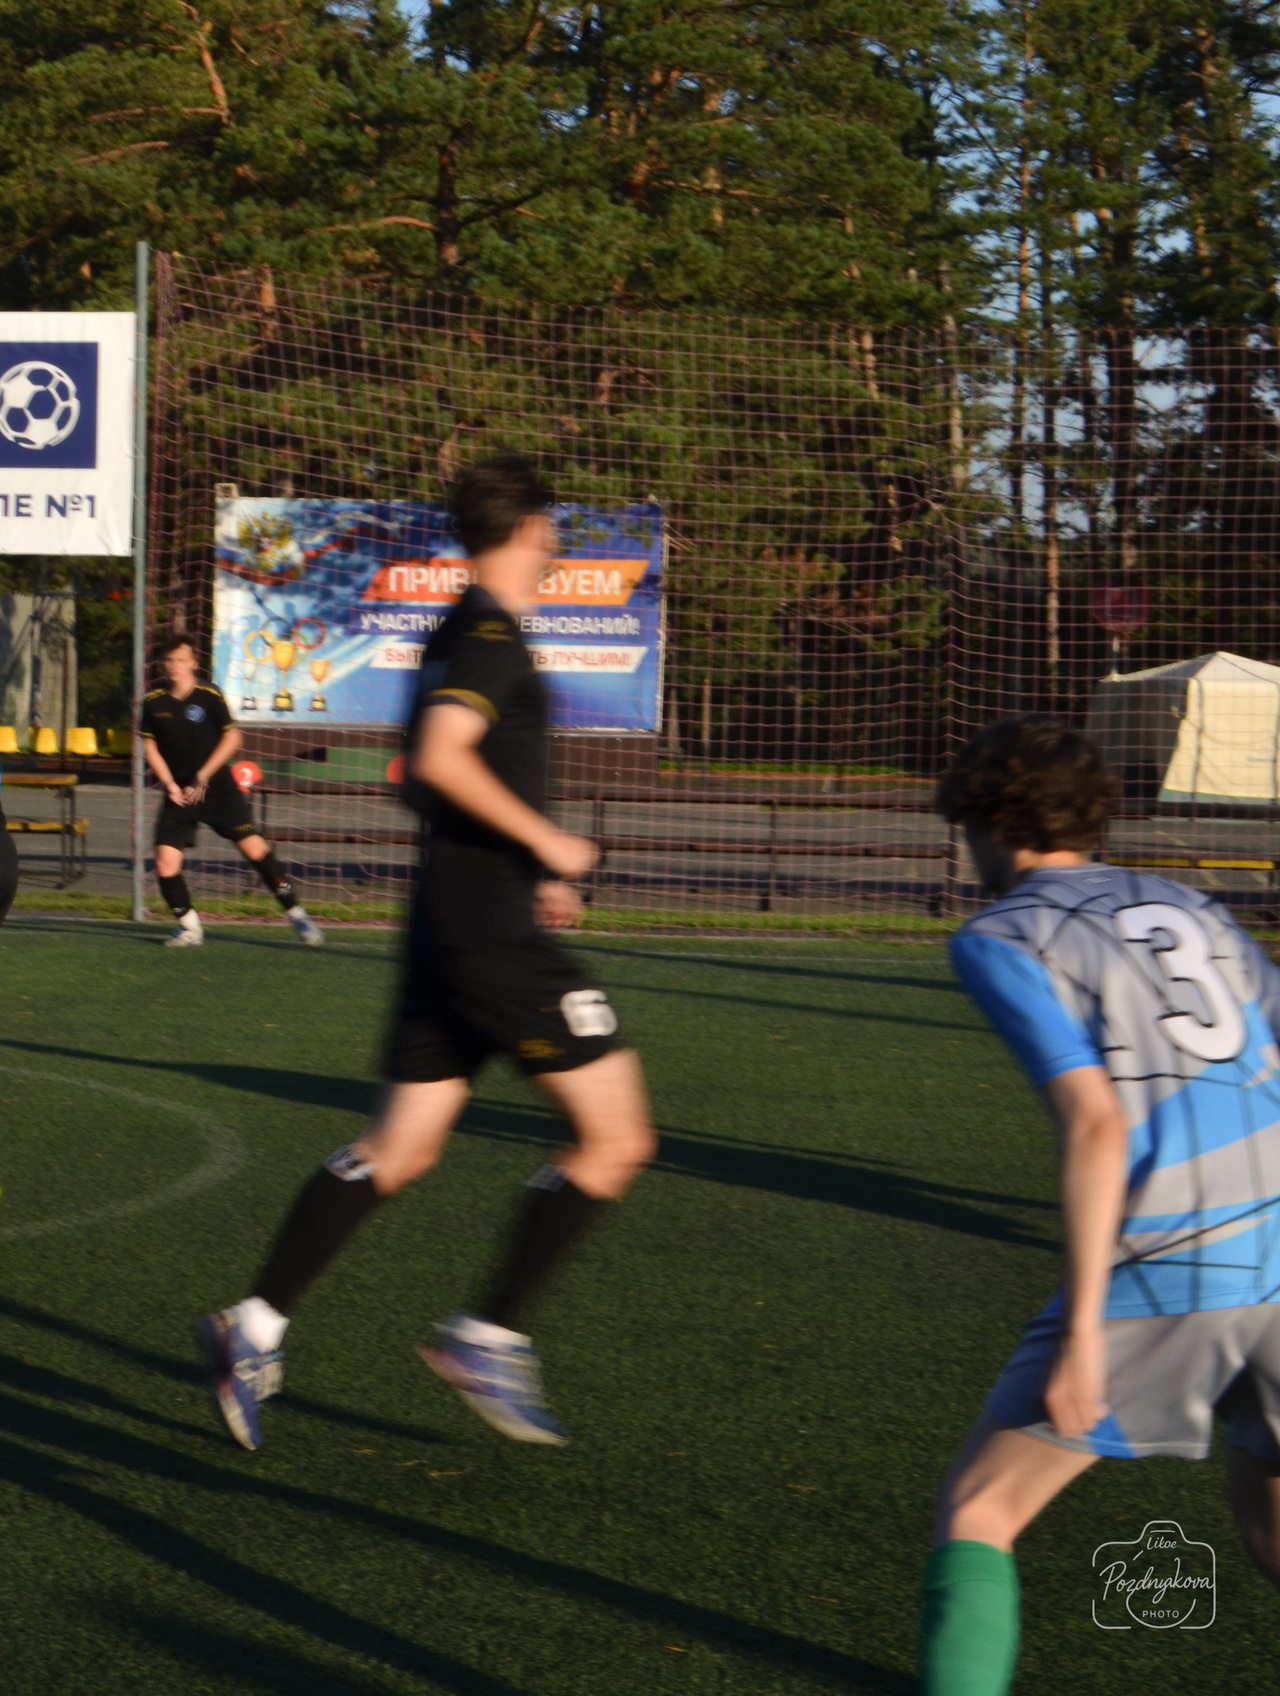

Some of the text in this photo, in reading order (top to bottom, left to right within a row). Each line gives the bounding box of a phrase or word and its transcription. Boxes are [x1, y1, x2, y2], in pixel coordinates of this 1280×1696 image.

[46, 495, 96, 518] №1
[388, 566, 622, 596] ПРИВВУЕМ
[361, 613, 640, 636] УЧАСТНИ ЕВНОВАНИЙ!
[385, 648, 428, 663] БЫТ
[238, 767, 254, 787] 2
[1117, 904, 1246, 1062] 3
